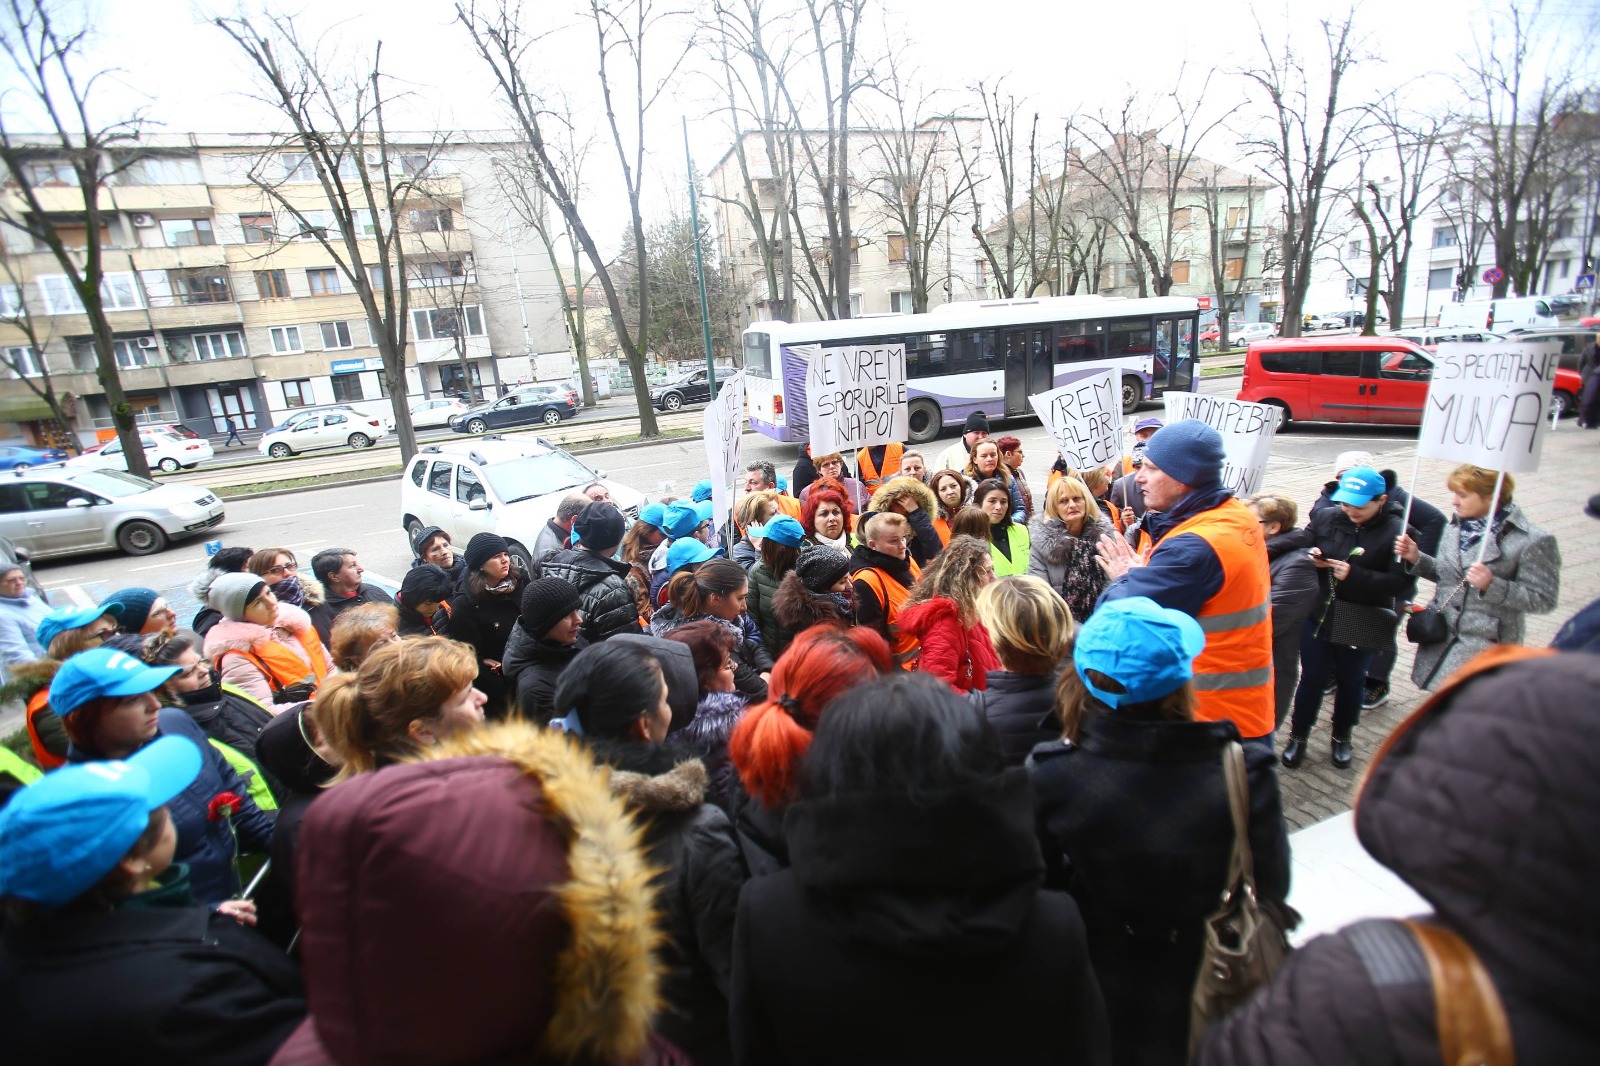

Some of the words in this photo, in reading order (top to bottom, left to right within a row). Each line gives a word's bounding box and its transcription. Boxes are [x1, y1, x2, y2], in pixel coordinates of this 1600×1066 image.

[813, 353, 835, 388] NE
[843, 348, 903, 382] VREM
[818, 382, 907, 417] SPORURILE
[1038, 377, 1114, 428] VREM
[1431, 391, 1542, 454] MUNCA
